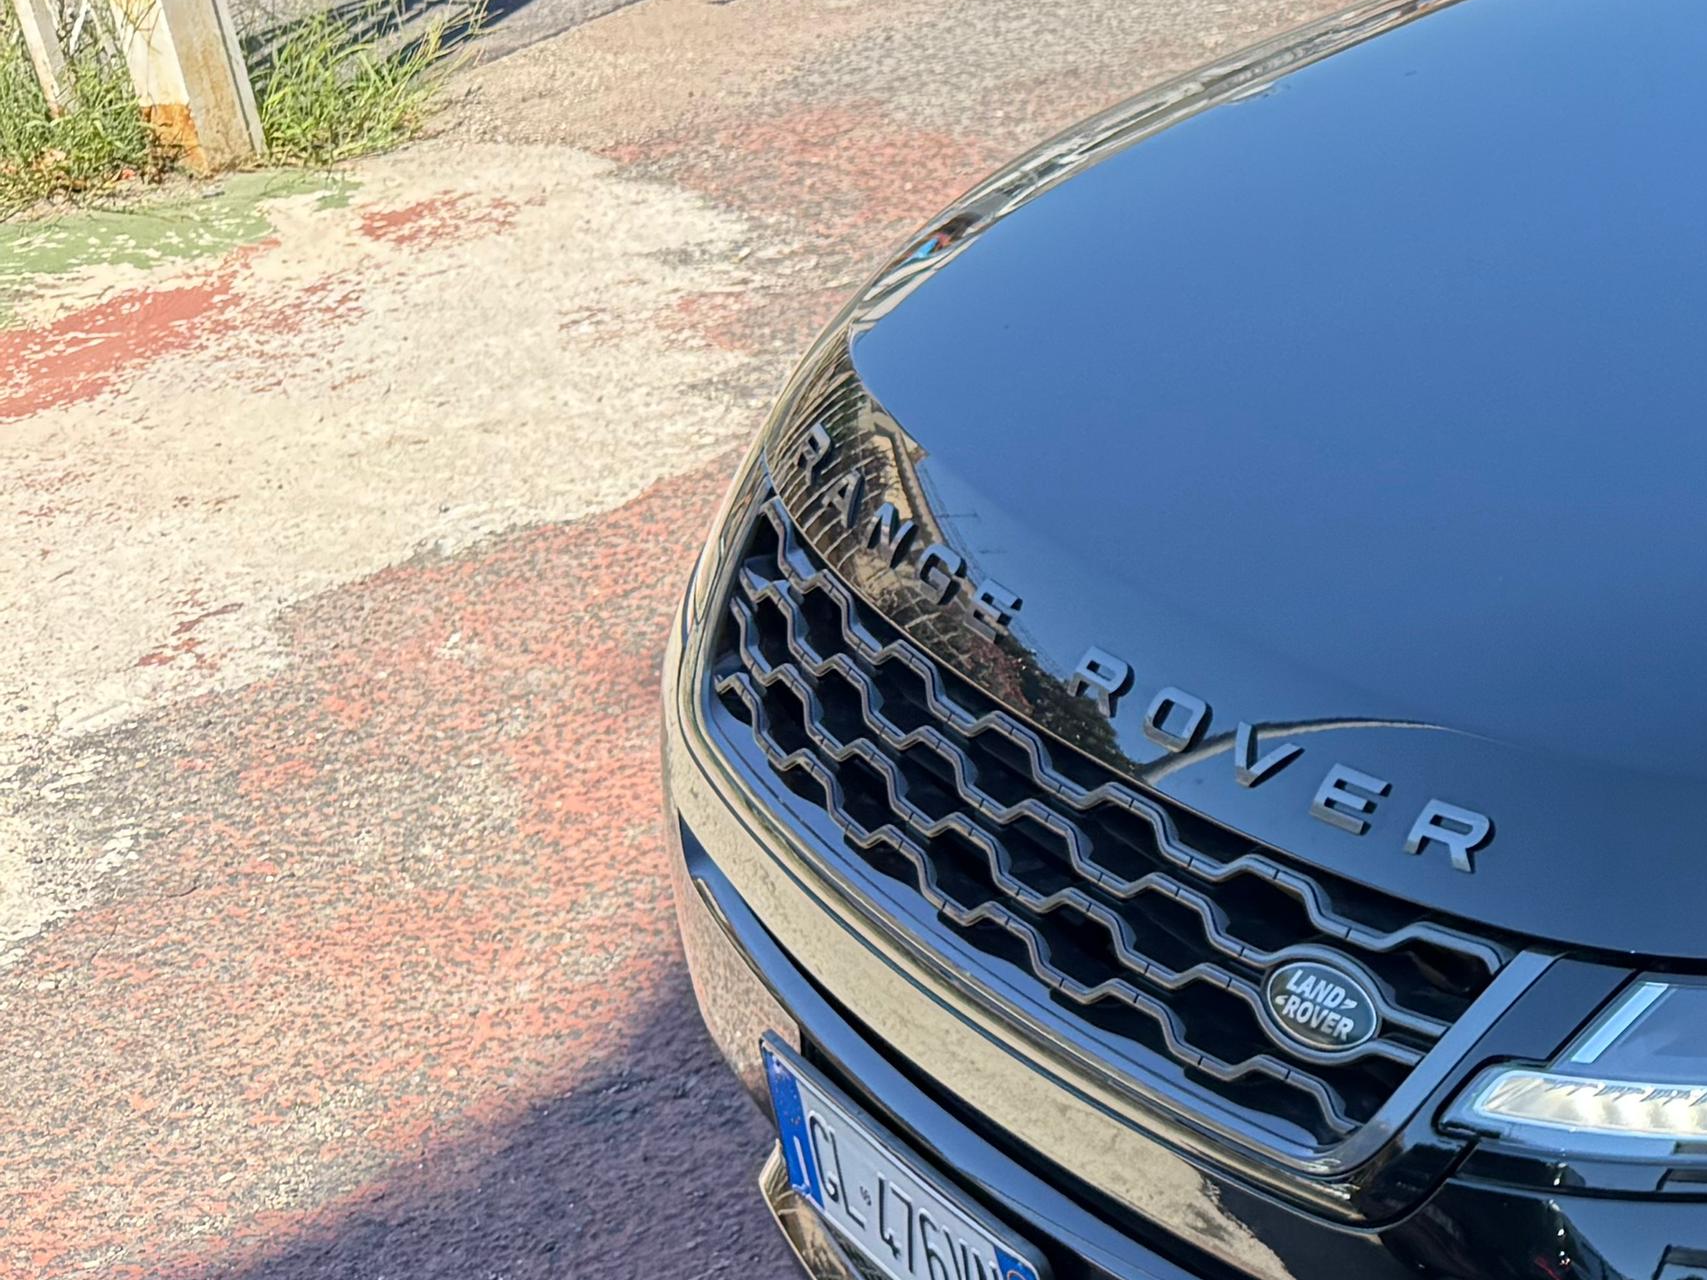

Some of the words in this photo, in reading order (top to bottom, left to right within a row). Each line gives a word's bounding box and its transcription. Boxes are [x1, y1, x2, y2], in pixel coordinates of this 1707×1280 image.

[793, 422, 1024, 644] RANGE
[1067, 643, 1496, 873] ROVER
[1281, 995, 1354, 1042] ROVER
[1286, 969, 1346, 1009] LAND
[809, 1109, 867, 1231] GL
